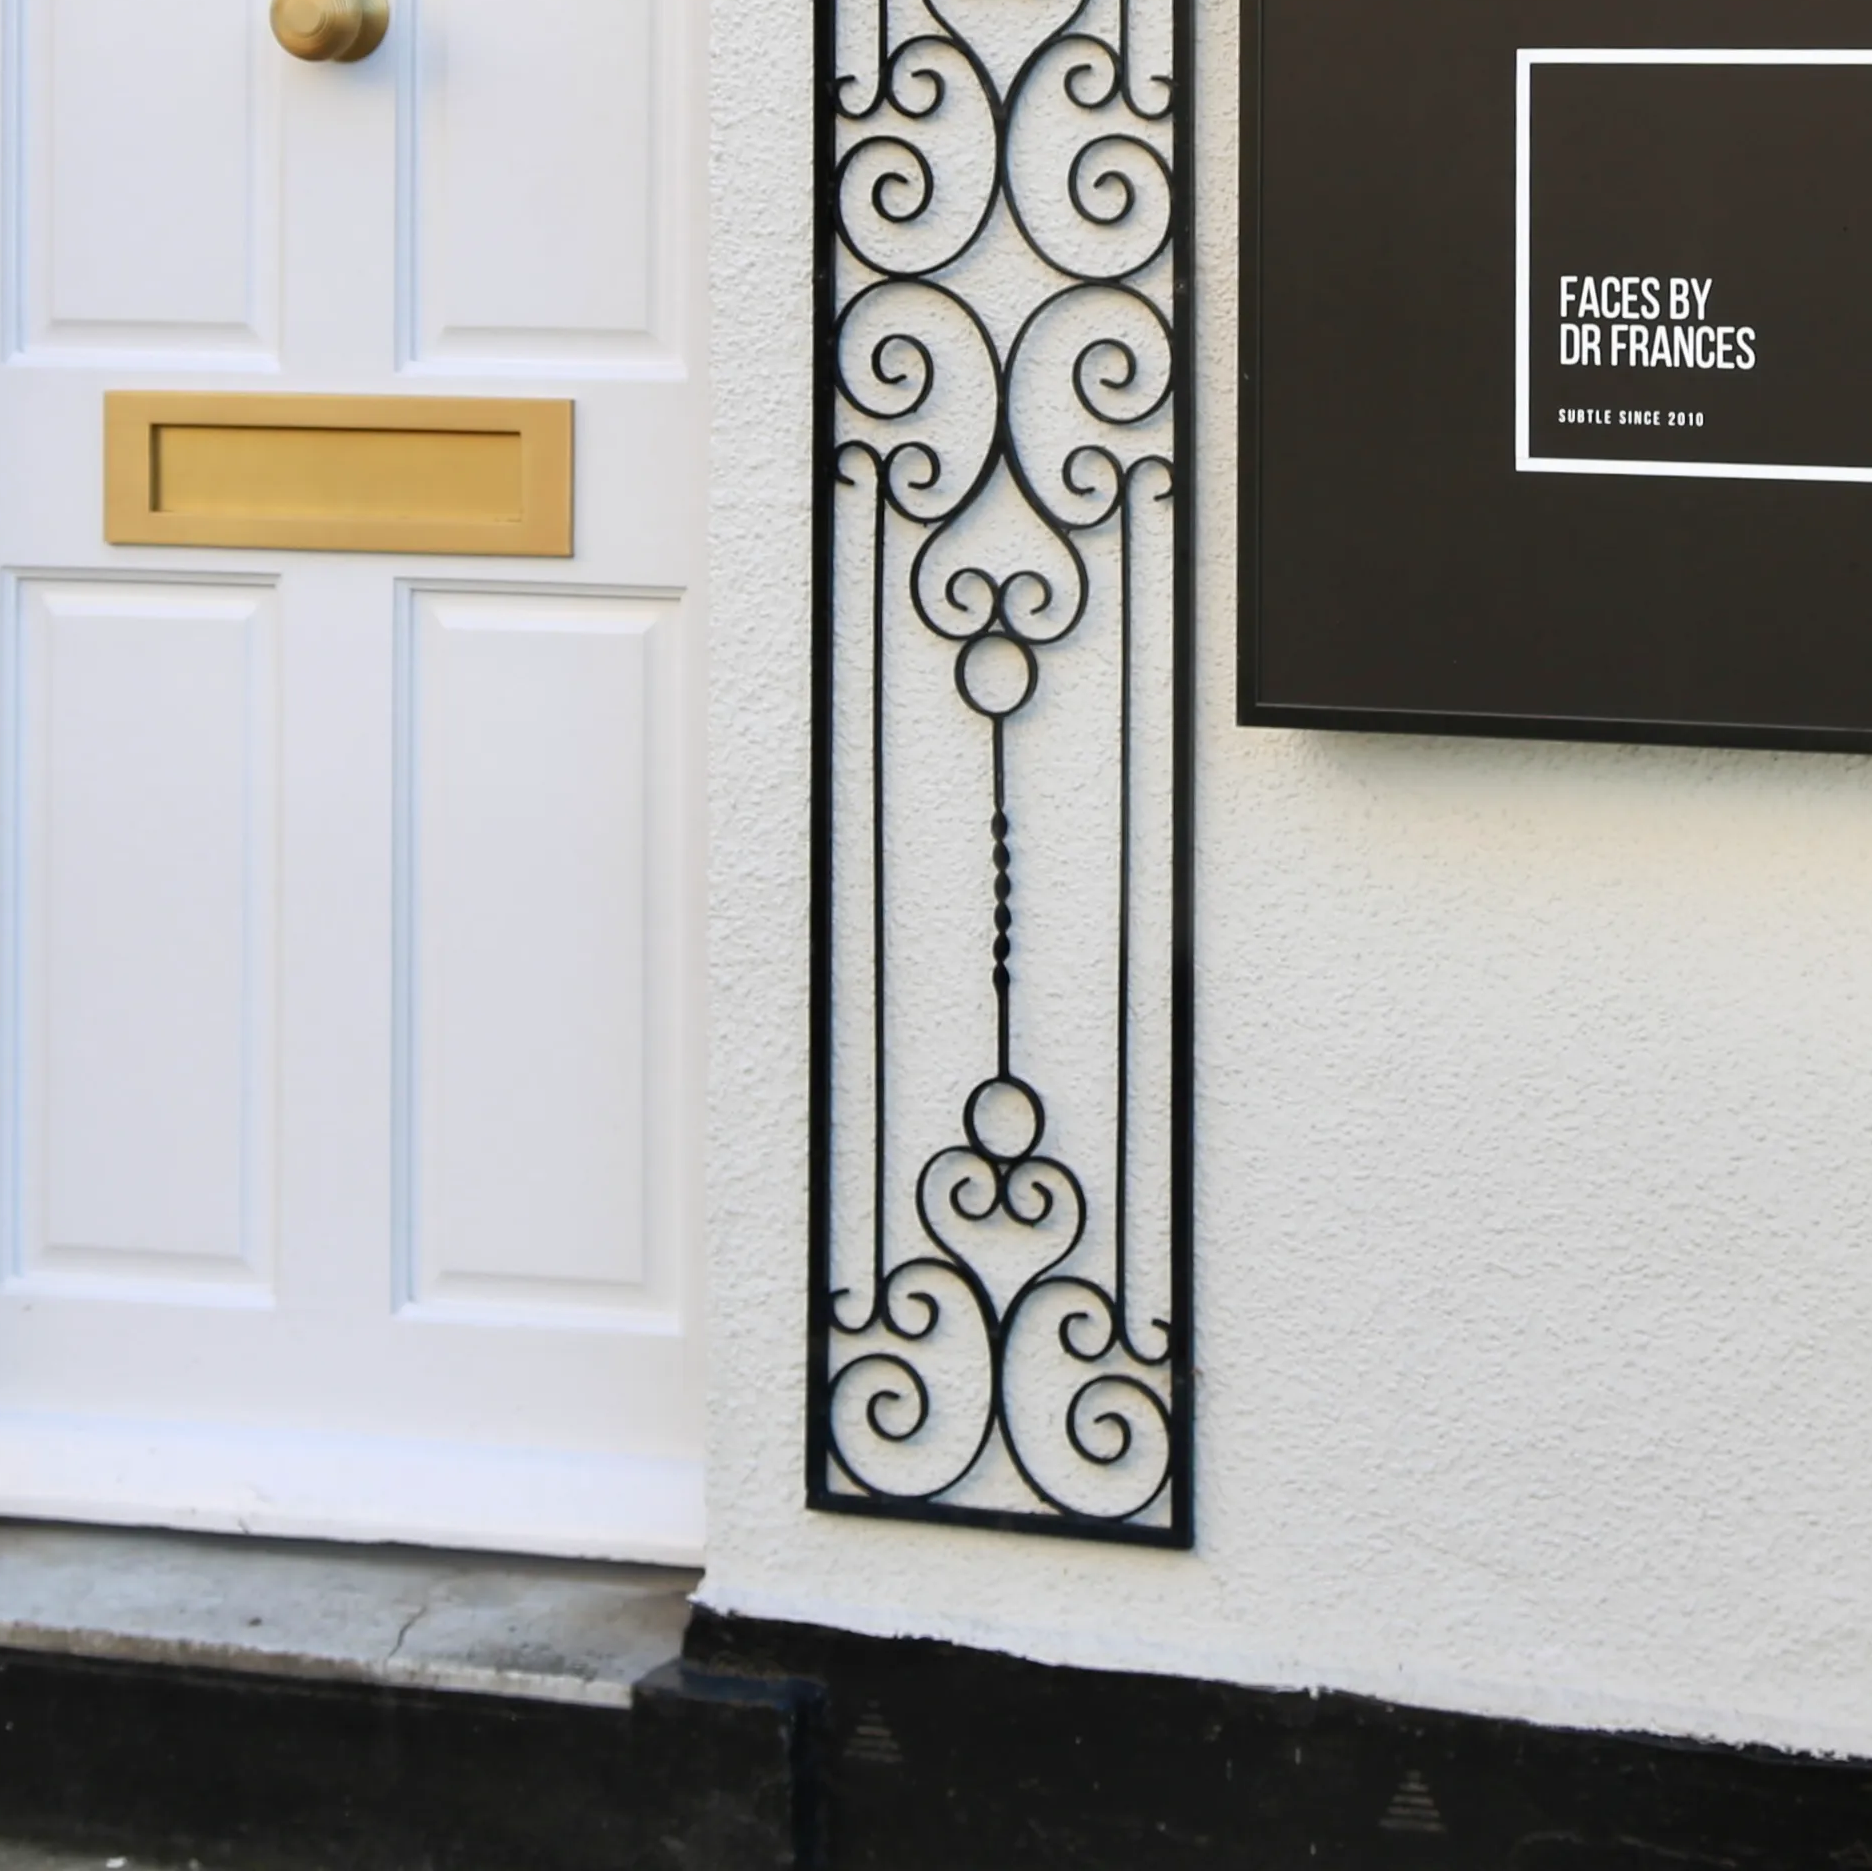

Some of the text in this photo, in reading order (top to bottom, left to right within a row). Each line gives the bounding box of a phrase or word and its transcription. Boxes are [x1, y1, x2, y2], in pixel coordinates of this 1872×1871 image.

[1560, 276, 1712, 320] FACES BY
[1560, 323, 1756, 369] DR FRANCES
[1558, 408, 1705, 427] SUBTLE SINCE 2010
